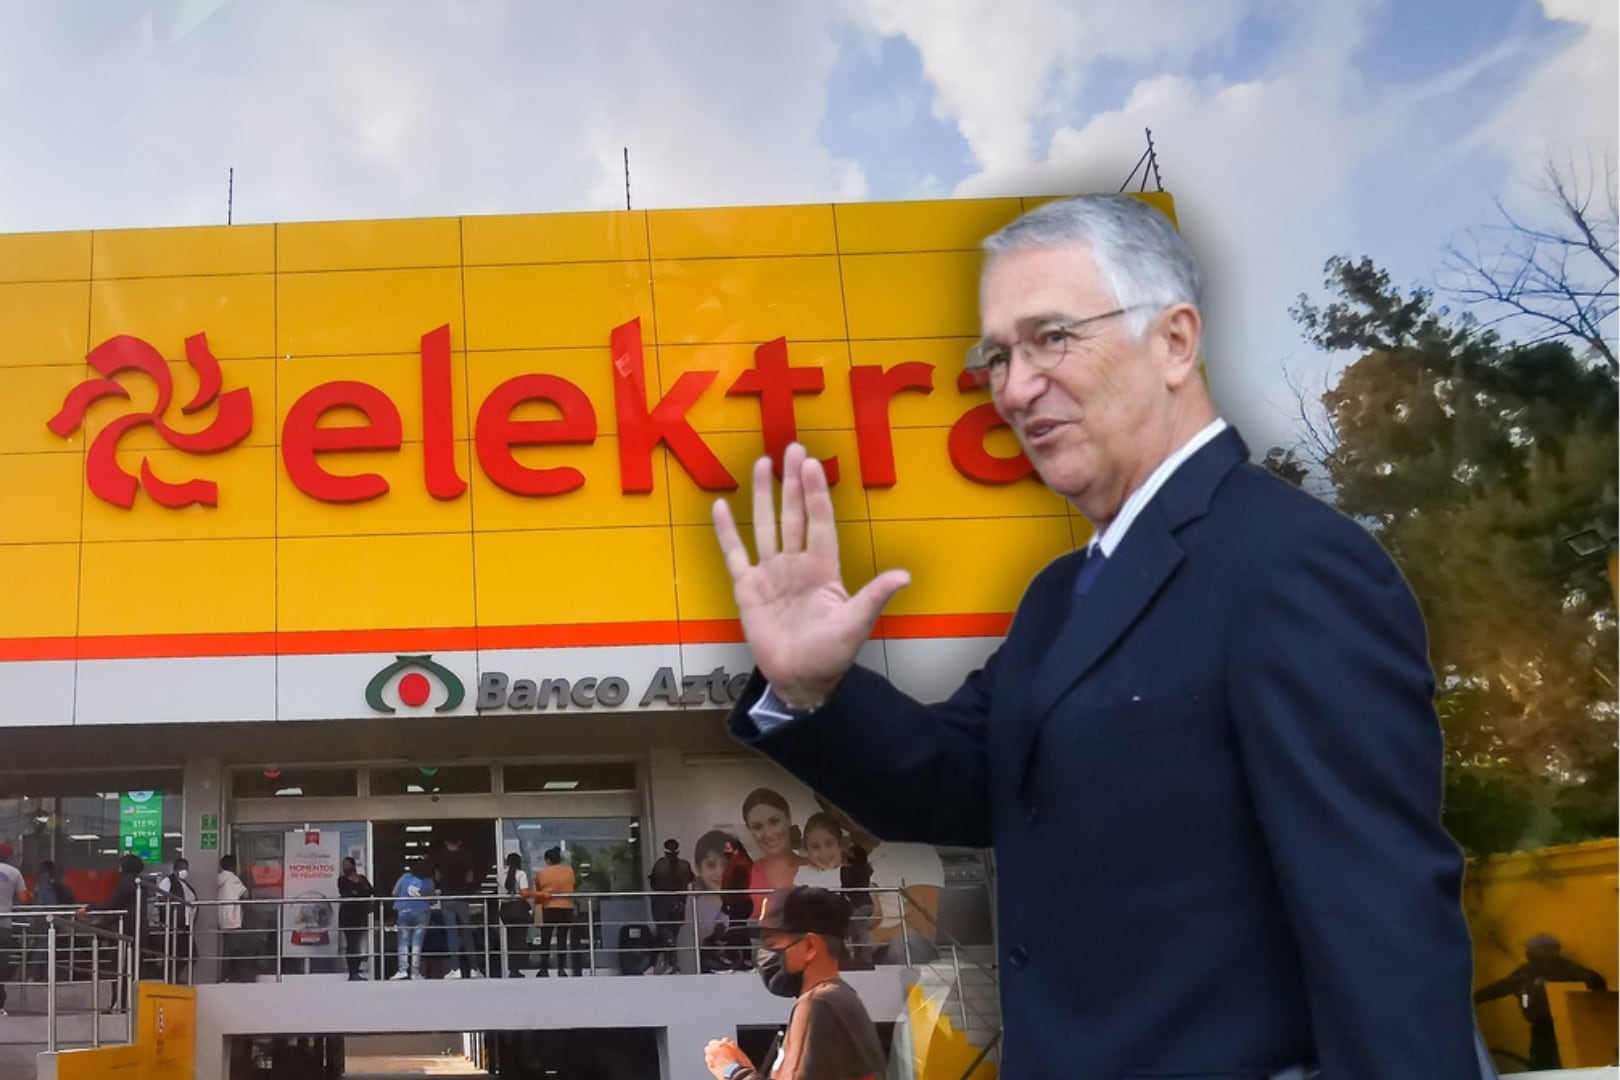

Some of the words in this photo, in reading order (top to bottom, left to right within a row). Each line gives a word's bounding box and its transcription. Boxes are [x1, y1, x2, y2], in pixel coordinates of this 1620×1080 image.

[281, 317, 1037, 505] elektra
[476, 671, 630, 711] Banco
[289, 864, 335, 872] MOMENTOS
